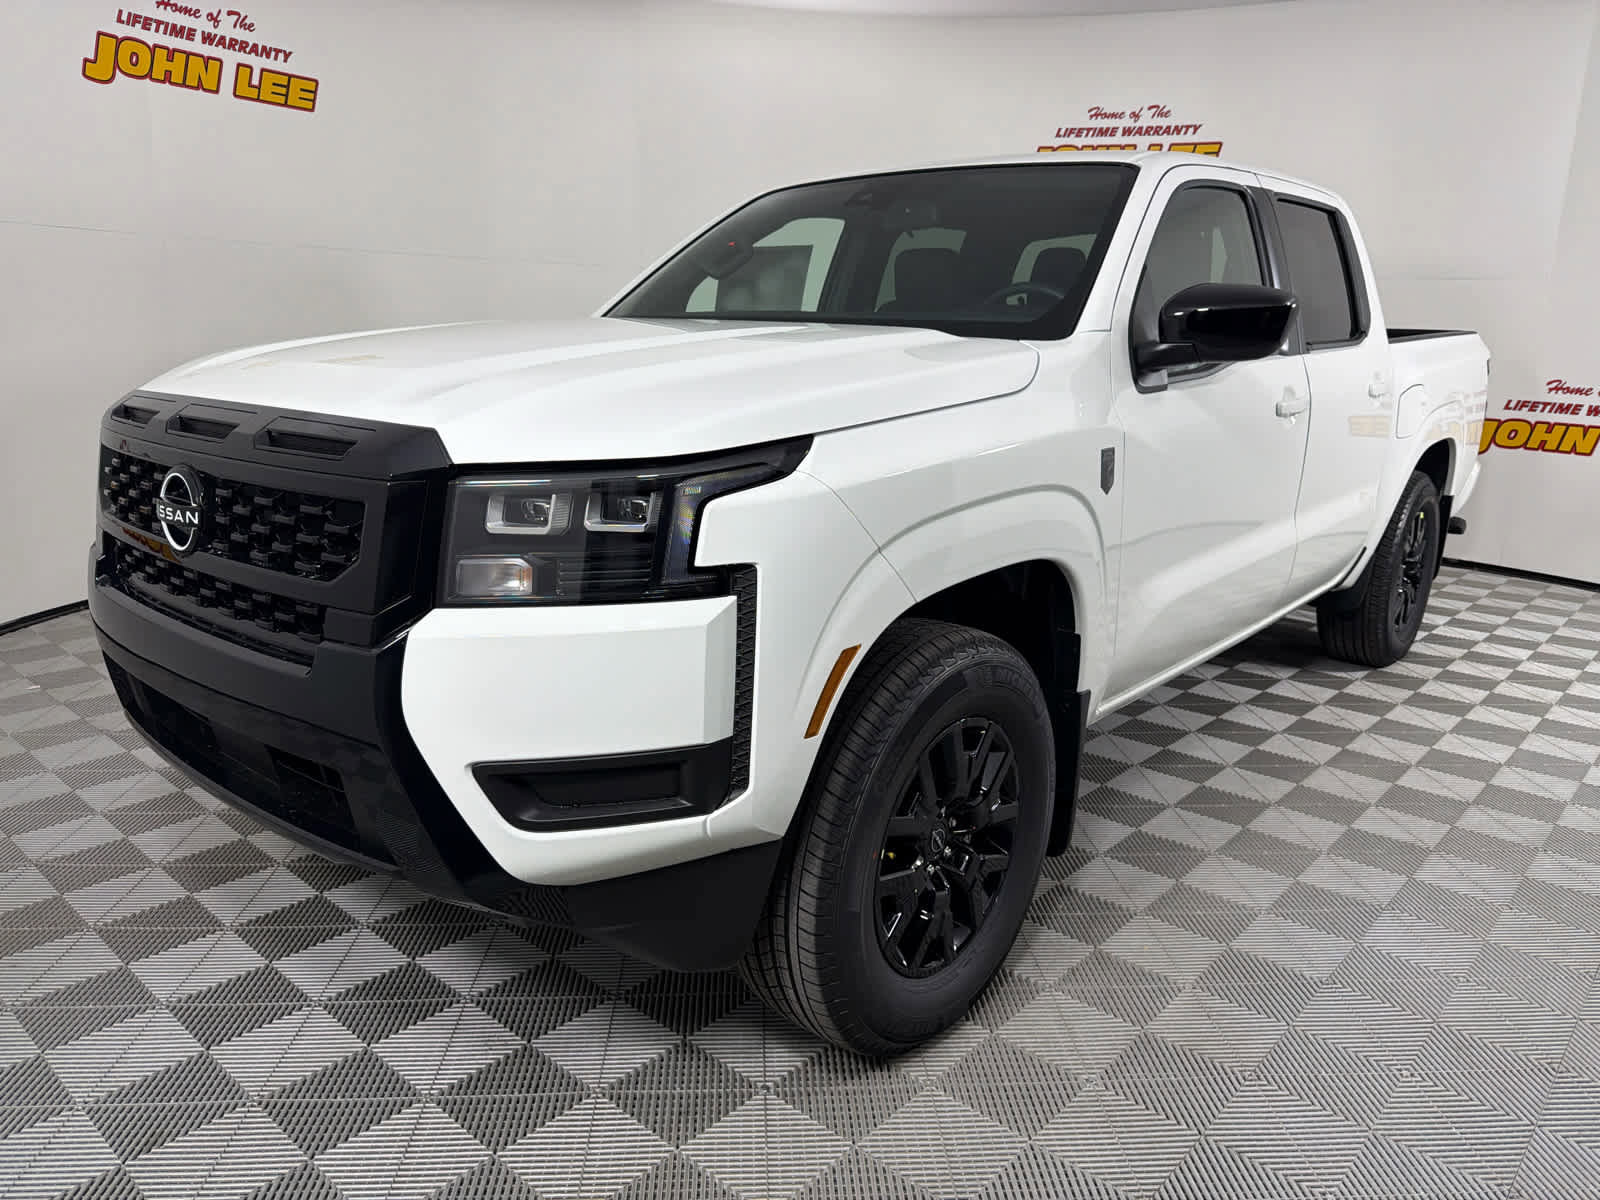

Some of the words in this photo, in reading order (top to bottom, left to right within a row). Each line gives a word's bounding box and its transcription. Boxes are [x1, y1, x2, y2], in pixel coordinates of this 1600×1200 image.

[206, 9, 222, 29] of
[227, 10, 256, 33] The
[116, 9, 197, 41] LIFETIME
[201, 30, 293, 64] WARRANTY
[82, 31, 223, 95] JOHN
[233, 62, 319, 112] LEE
[1087, 106, 1125, 120] Home
[1128, 107, 1143, 123] of
[1147, 104, 1172, 119] The
[1055, 126, 1120, 138] LIFETIME
[1121, 124, 1203, 138] WARRANTY
[1546, 379, 1594, 397] Home
[1503, 399, 1584, 416] LIFETIME
[1478, 417, 1600, 456] JOHN
